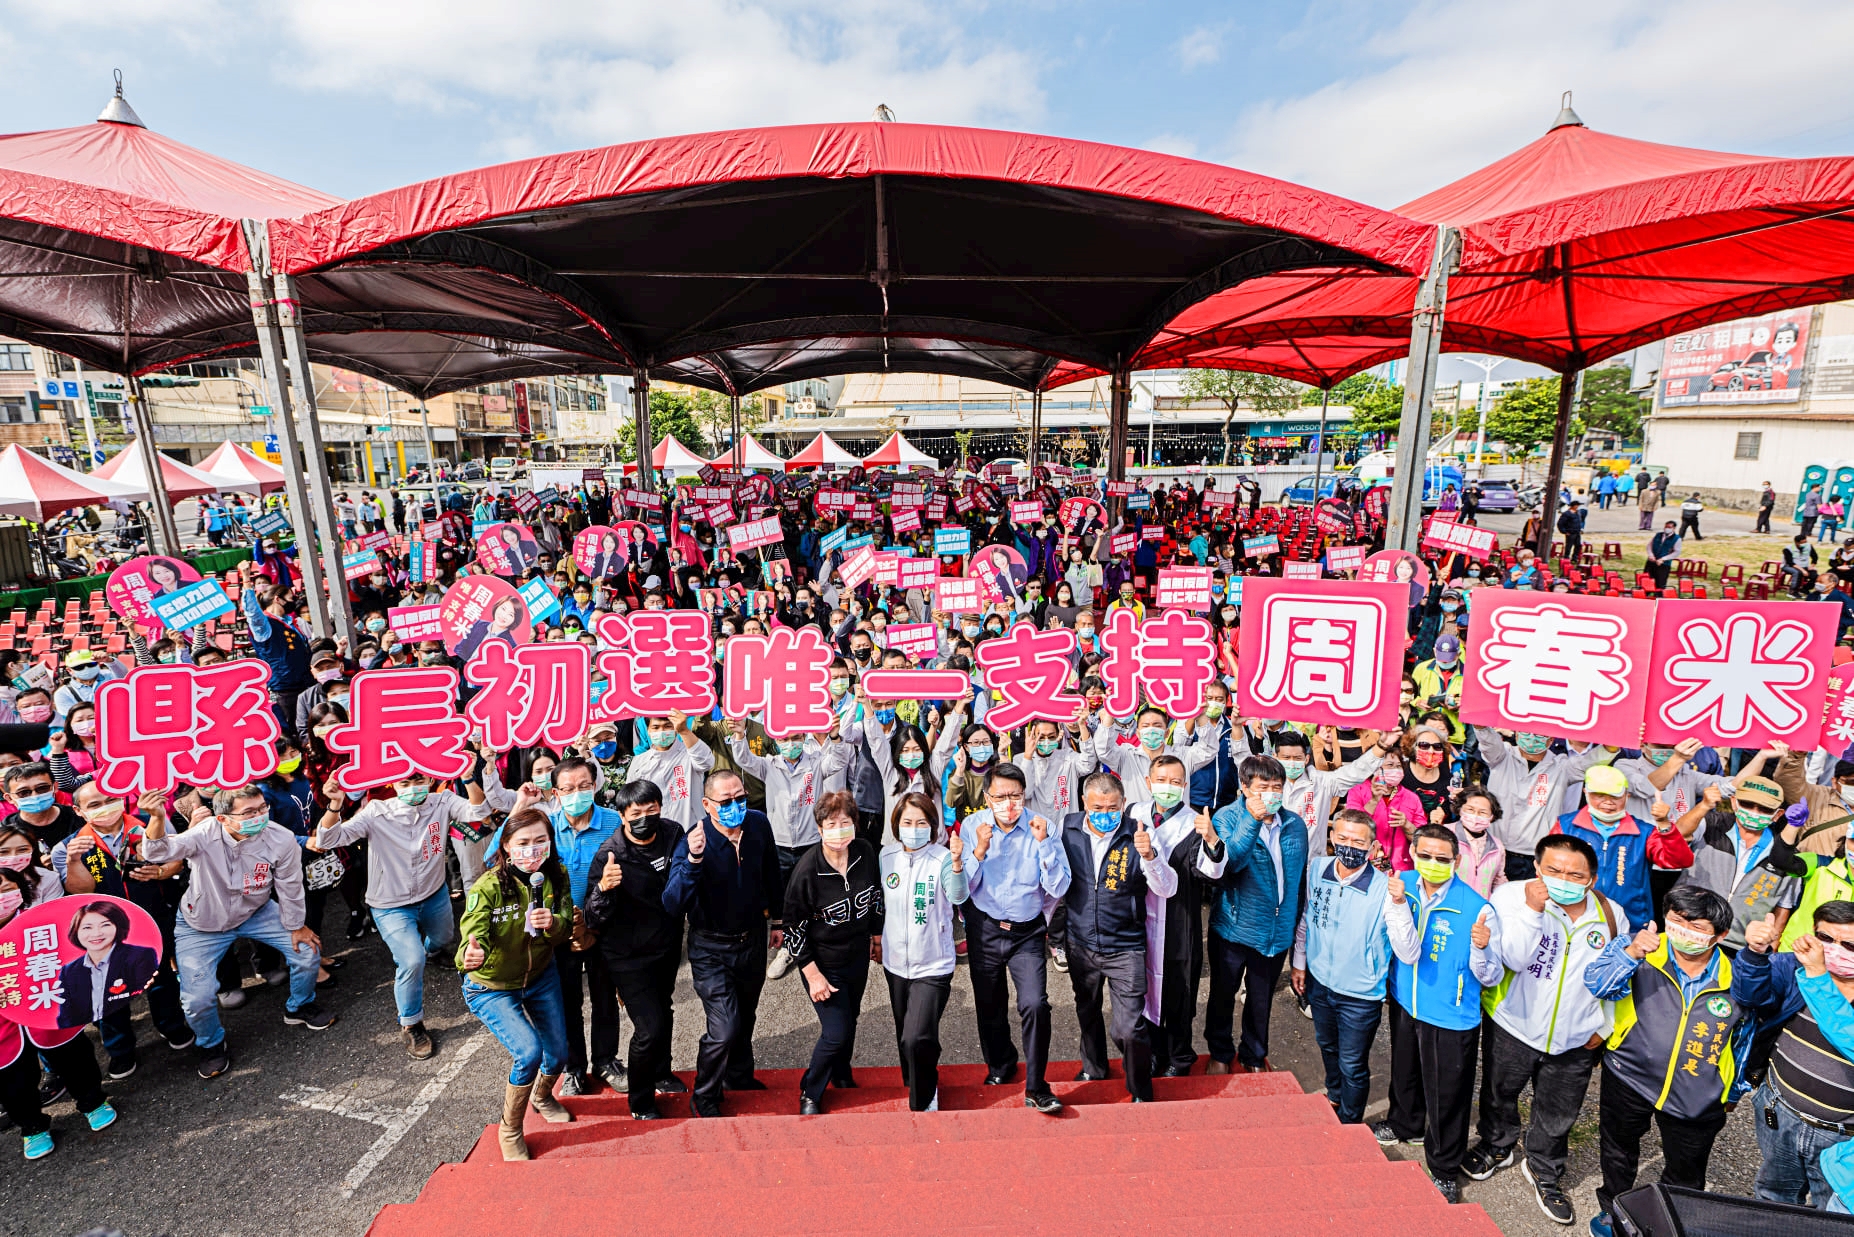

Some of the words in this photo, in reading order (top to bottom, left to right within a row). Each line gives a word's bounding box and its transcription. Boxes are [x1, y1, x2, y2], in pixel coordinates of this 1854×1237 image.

[1672, 331, 1712, 353] 冠虹
[1713, 327, 1751, 349] 租車
[264, 435, 273, 447] P
[1287, 423, 1321, 431] watson
[1067, 501, 1083, 527] 周春米
[486, 535, 512, 570] 周春米
[576, 535, 586, 563] 唯一支持
[584, 533, 598, 568] 周春米
[936, 532, 968, 543] 在地力量
[122, 572, 157, 618] 周春米
[977, 559, 1002, 597] 周春米
[1159, 576, 1209, 589] 義無反顧
[158, 581, 218, 618] 在地力量
[442, 581, 472, 622] 唯一支持
[451, 584, 494, 640] 周春米
[1160, 590, 1210, 604] 當仁不讓
[889, 626, 934, 644] 義無反顧
[596, 609, 717, 719] 選
[1099, 608, 1218, 720] 持
[1250, 591, 1388, 718] 周
[1478, 603, 1631, 730] 春
[723, 625, 835, 738] 唯
[861, 669, 971, 701] 一
[975, 622, 1087, 733] 支
[1659, 611, 1816, 738] 米
[464, 639, 591, 752] 初
[95, 657, 282, 798] 縣
[325, 665, 475, 792] 長
[673, 764, 689, 800] 周春米
[803, 772, 815, 806] 周春米
[1057, 775, 1070, 809] 周春米
[1535, 773, 1548, 807] 周春米
[1303, 791, 1317, 827] 周春米
[1674, 787, 1688, 818] 周春
[428, 821, 442, 857] 周春米
[253, 862, 270, 893] 周春米
[1105, 849, 1121, 891] 蔣家煌
[914, 882, 927, 926] 周春米
[0, 941, 22, 1009] 唯一支持
[23, 923, 66, 1011] 周春米
[1706, 1021, 1728, 1066] 市民代表
